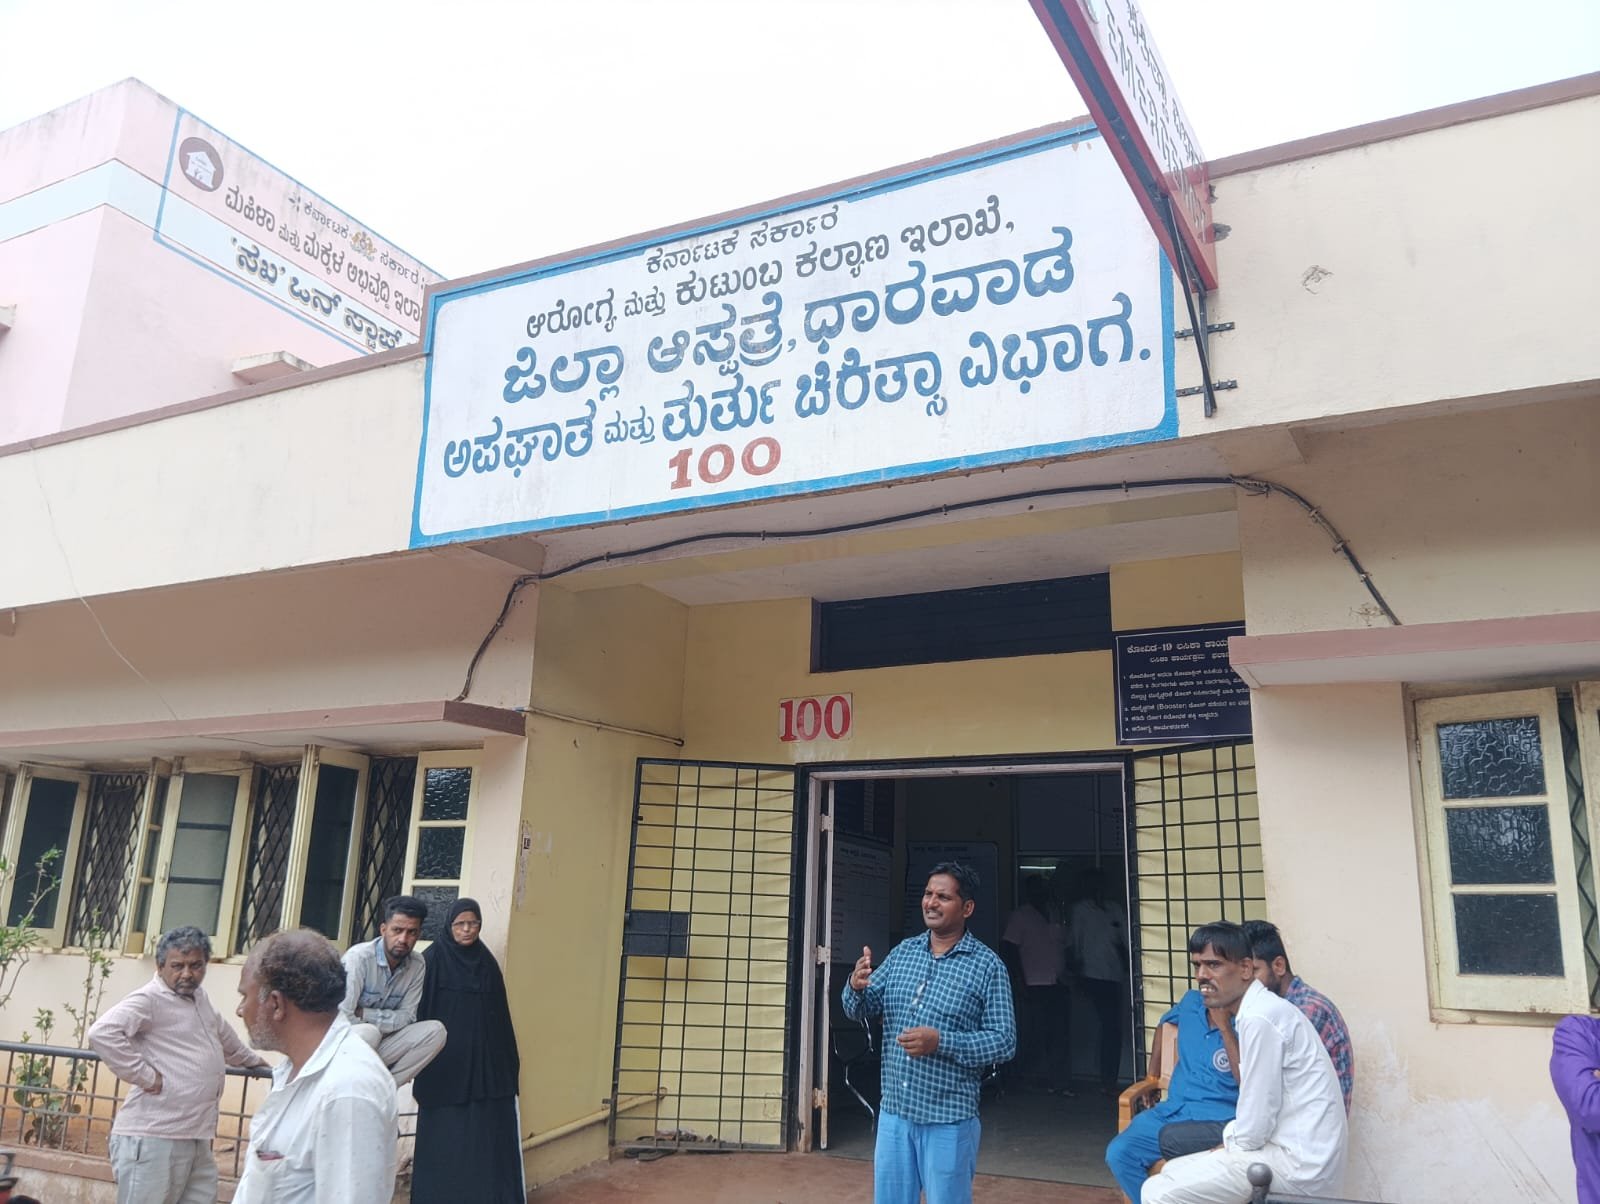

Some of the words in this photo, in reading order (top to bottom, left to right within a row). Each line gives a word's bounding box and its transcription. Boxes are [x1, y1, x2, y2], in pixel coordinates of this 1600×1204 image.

[225, 185, 276, 233] ಮಹಿಳಾ
[304, 232, 345, 275] ಮಕ್ಕಳ
[394, 290, 423, 322] ಇಲಾ
[526, 287, 617, 339] ಆರೋಗ್ಯ
[624, 285, 666, 317] ಮತ್ತು
[675, 258, 783, 306] ಕುಟುಂಬ
[795, 233, 890, 279] ಕಲ್ಯಾಣ
[900, 193, 1015, 253] ಇಲಾಖೆ,
[646, 230, 740, 274] ಕರ್ನಾಟಕ
[749, 204, 839, 250] ಸರ್ಕಾರ
[289, 276, 342, 316] ಒನ್
[502, 344, 625, 404] ಜಿಲ್ಲಾ
[647, 290, 797, 377] ಆಸ್ಪತ್ರೆ,
[803, 225, 1075, 355] ಧಾರವಾಡ
[442, 398, 597, 479] ಅಪಘಾತ
[603, 405, 656, 445] ಮತ್ತು
[661, 371, 782, 442] ತುರ್ತು
[794, 346, 948, 417] ಚಿಕಿತ್ಸಾ
[959, 291, 1152, 395] ವಿಭಾಗ.
[668, 436, 782, 490] 100
[779, 694, 851, 742] 100
